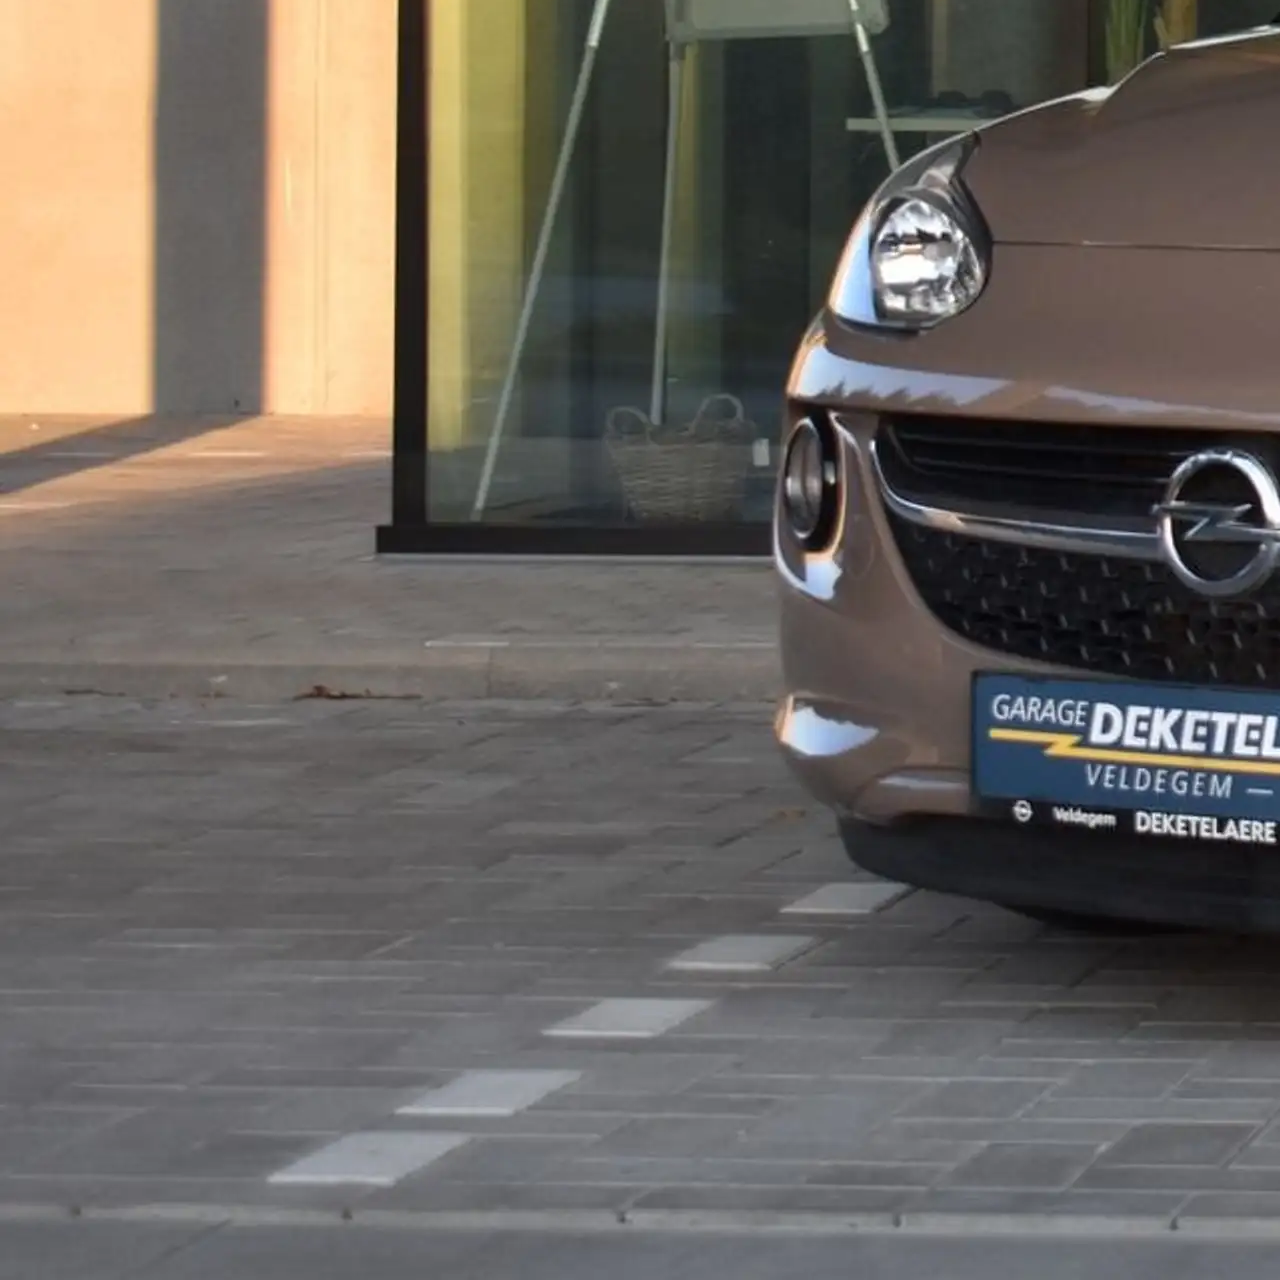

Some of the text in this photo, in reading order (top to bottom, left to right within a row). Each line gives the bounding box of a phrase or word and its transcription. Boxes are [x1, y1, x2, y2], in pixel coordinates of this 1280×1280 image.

[991, 693, 1088, 727] GARAGE
[1085, 764, 1234, 799] VELDEGEM
[1052, 805, 1117, 828] Veldegem
[1134, 811, 1277, 844] DEKETELAERE
